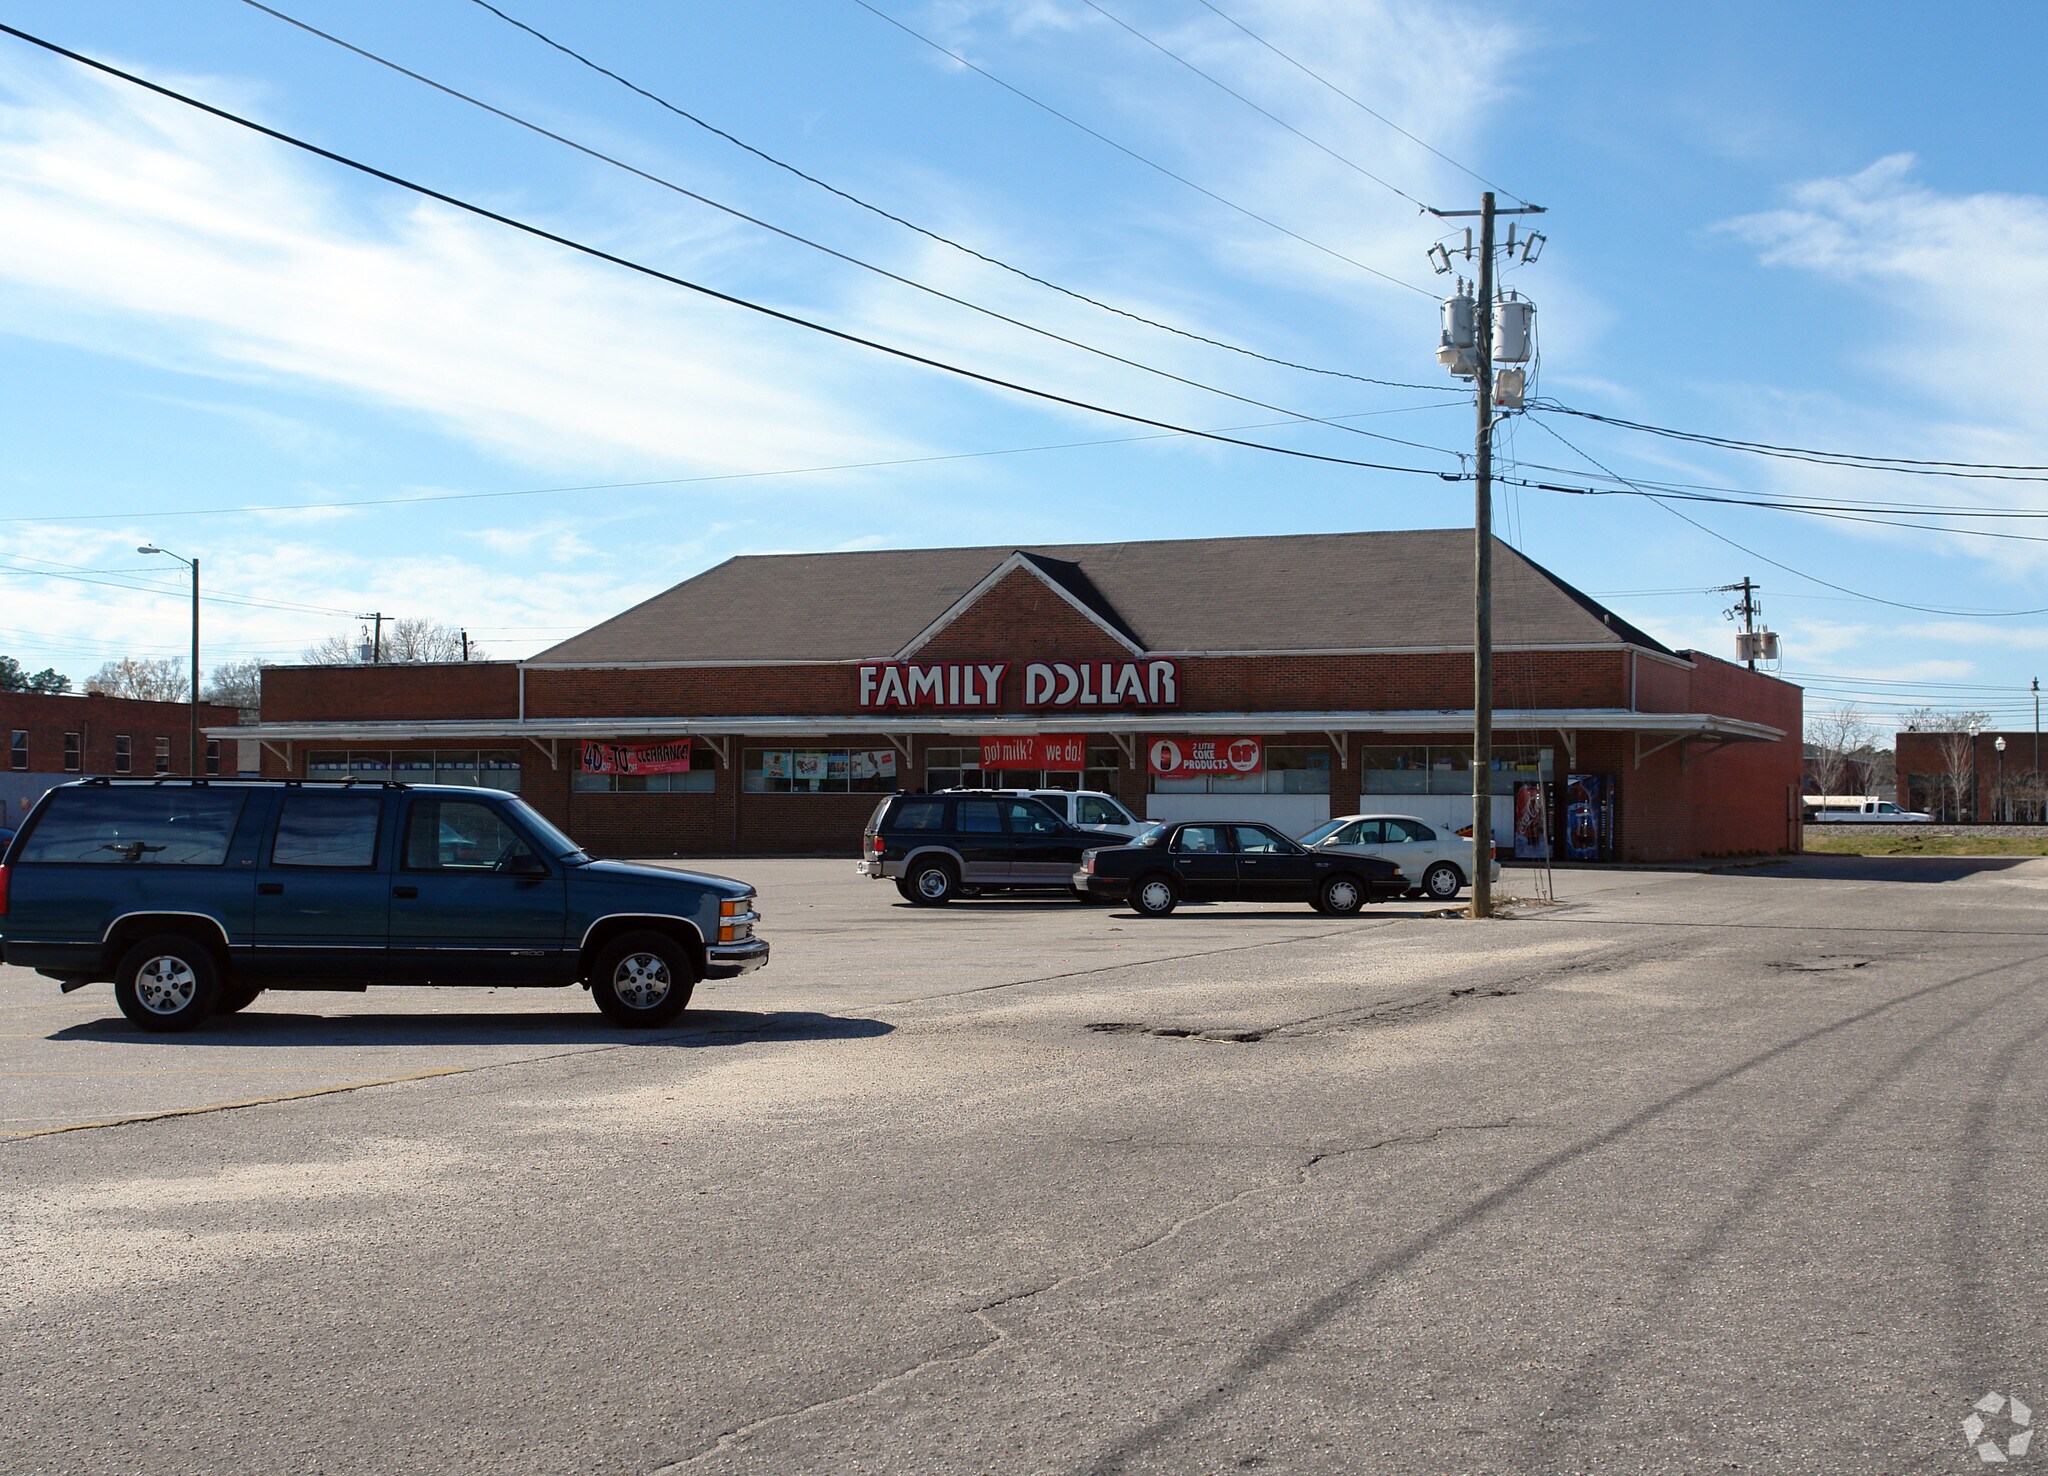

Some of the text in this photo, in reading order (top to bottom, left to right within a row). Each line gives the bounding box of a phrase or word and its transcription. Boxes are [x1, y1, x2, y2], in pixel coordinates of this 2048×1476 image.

[859, 661, 1177, 706] FAMILY DOLLAR
[636, 743, 689, 763] CLEARANCE!
[984, 739, 1082, 765] got milk? we do!
[1193, 750, 1215, 760] COKE
[1183, 760, 1228, 770] PRODUCTS
